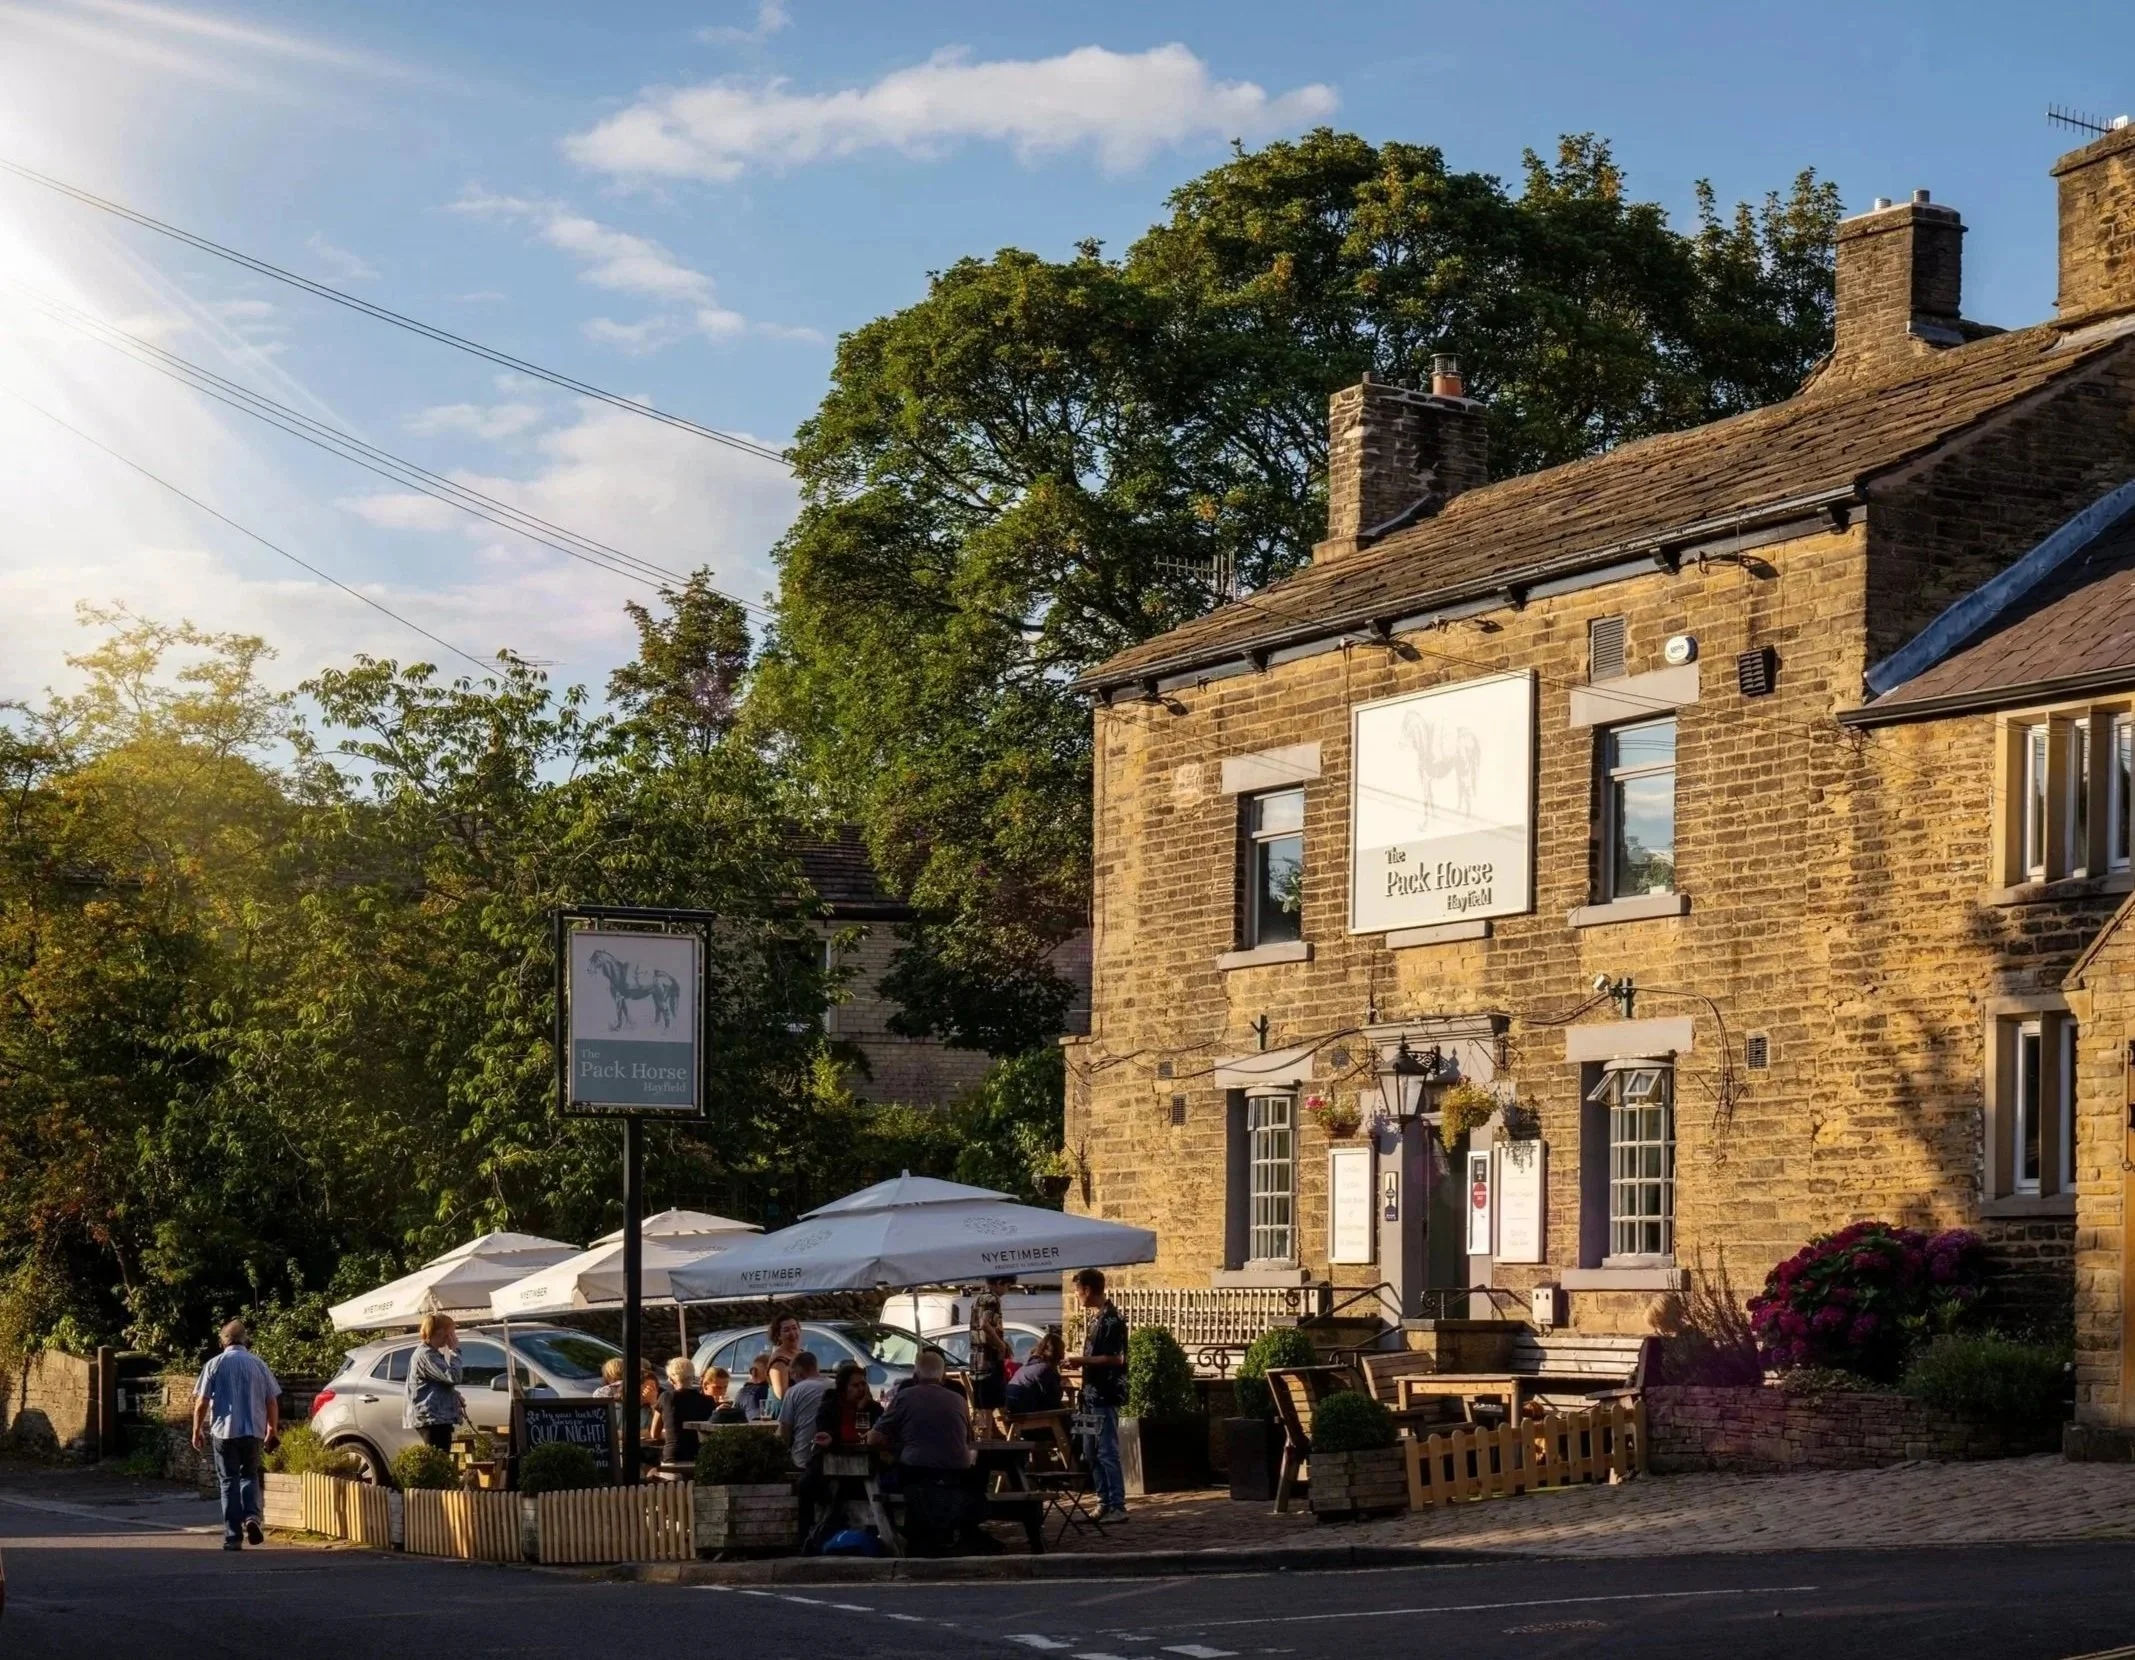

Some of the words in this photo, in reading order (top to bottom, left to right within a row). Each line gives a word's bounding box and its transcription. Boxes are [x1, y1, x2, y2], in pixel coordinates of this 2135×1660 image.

[1385, 847, 1406, 864] The
[1385, 862, 1431, 897] Pack
[1434, 861, 1493, 889] Horse
[1447, 887, 1493, 912] Hayfield
[581, 1047, 600, 1059] The
[580, 1060, 627, 1079] Pack
[631, 1062, 688, 1081] Horse
[643, 1081, 687, 1095] Hayfield
[981, 1246, 1060, 1263] NYETIMBER
[741, 1267, 803, 1281] NYETIMBER
[530, 1424, 560, 1445] QUIZ
[565, 1424, 606, 1442] NIGHT!
